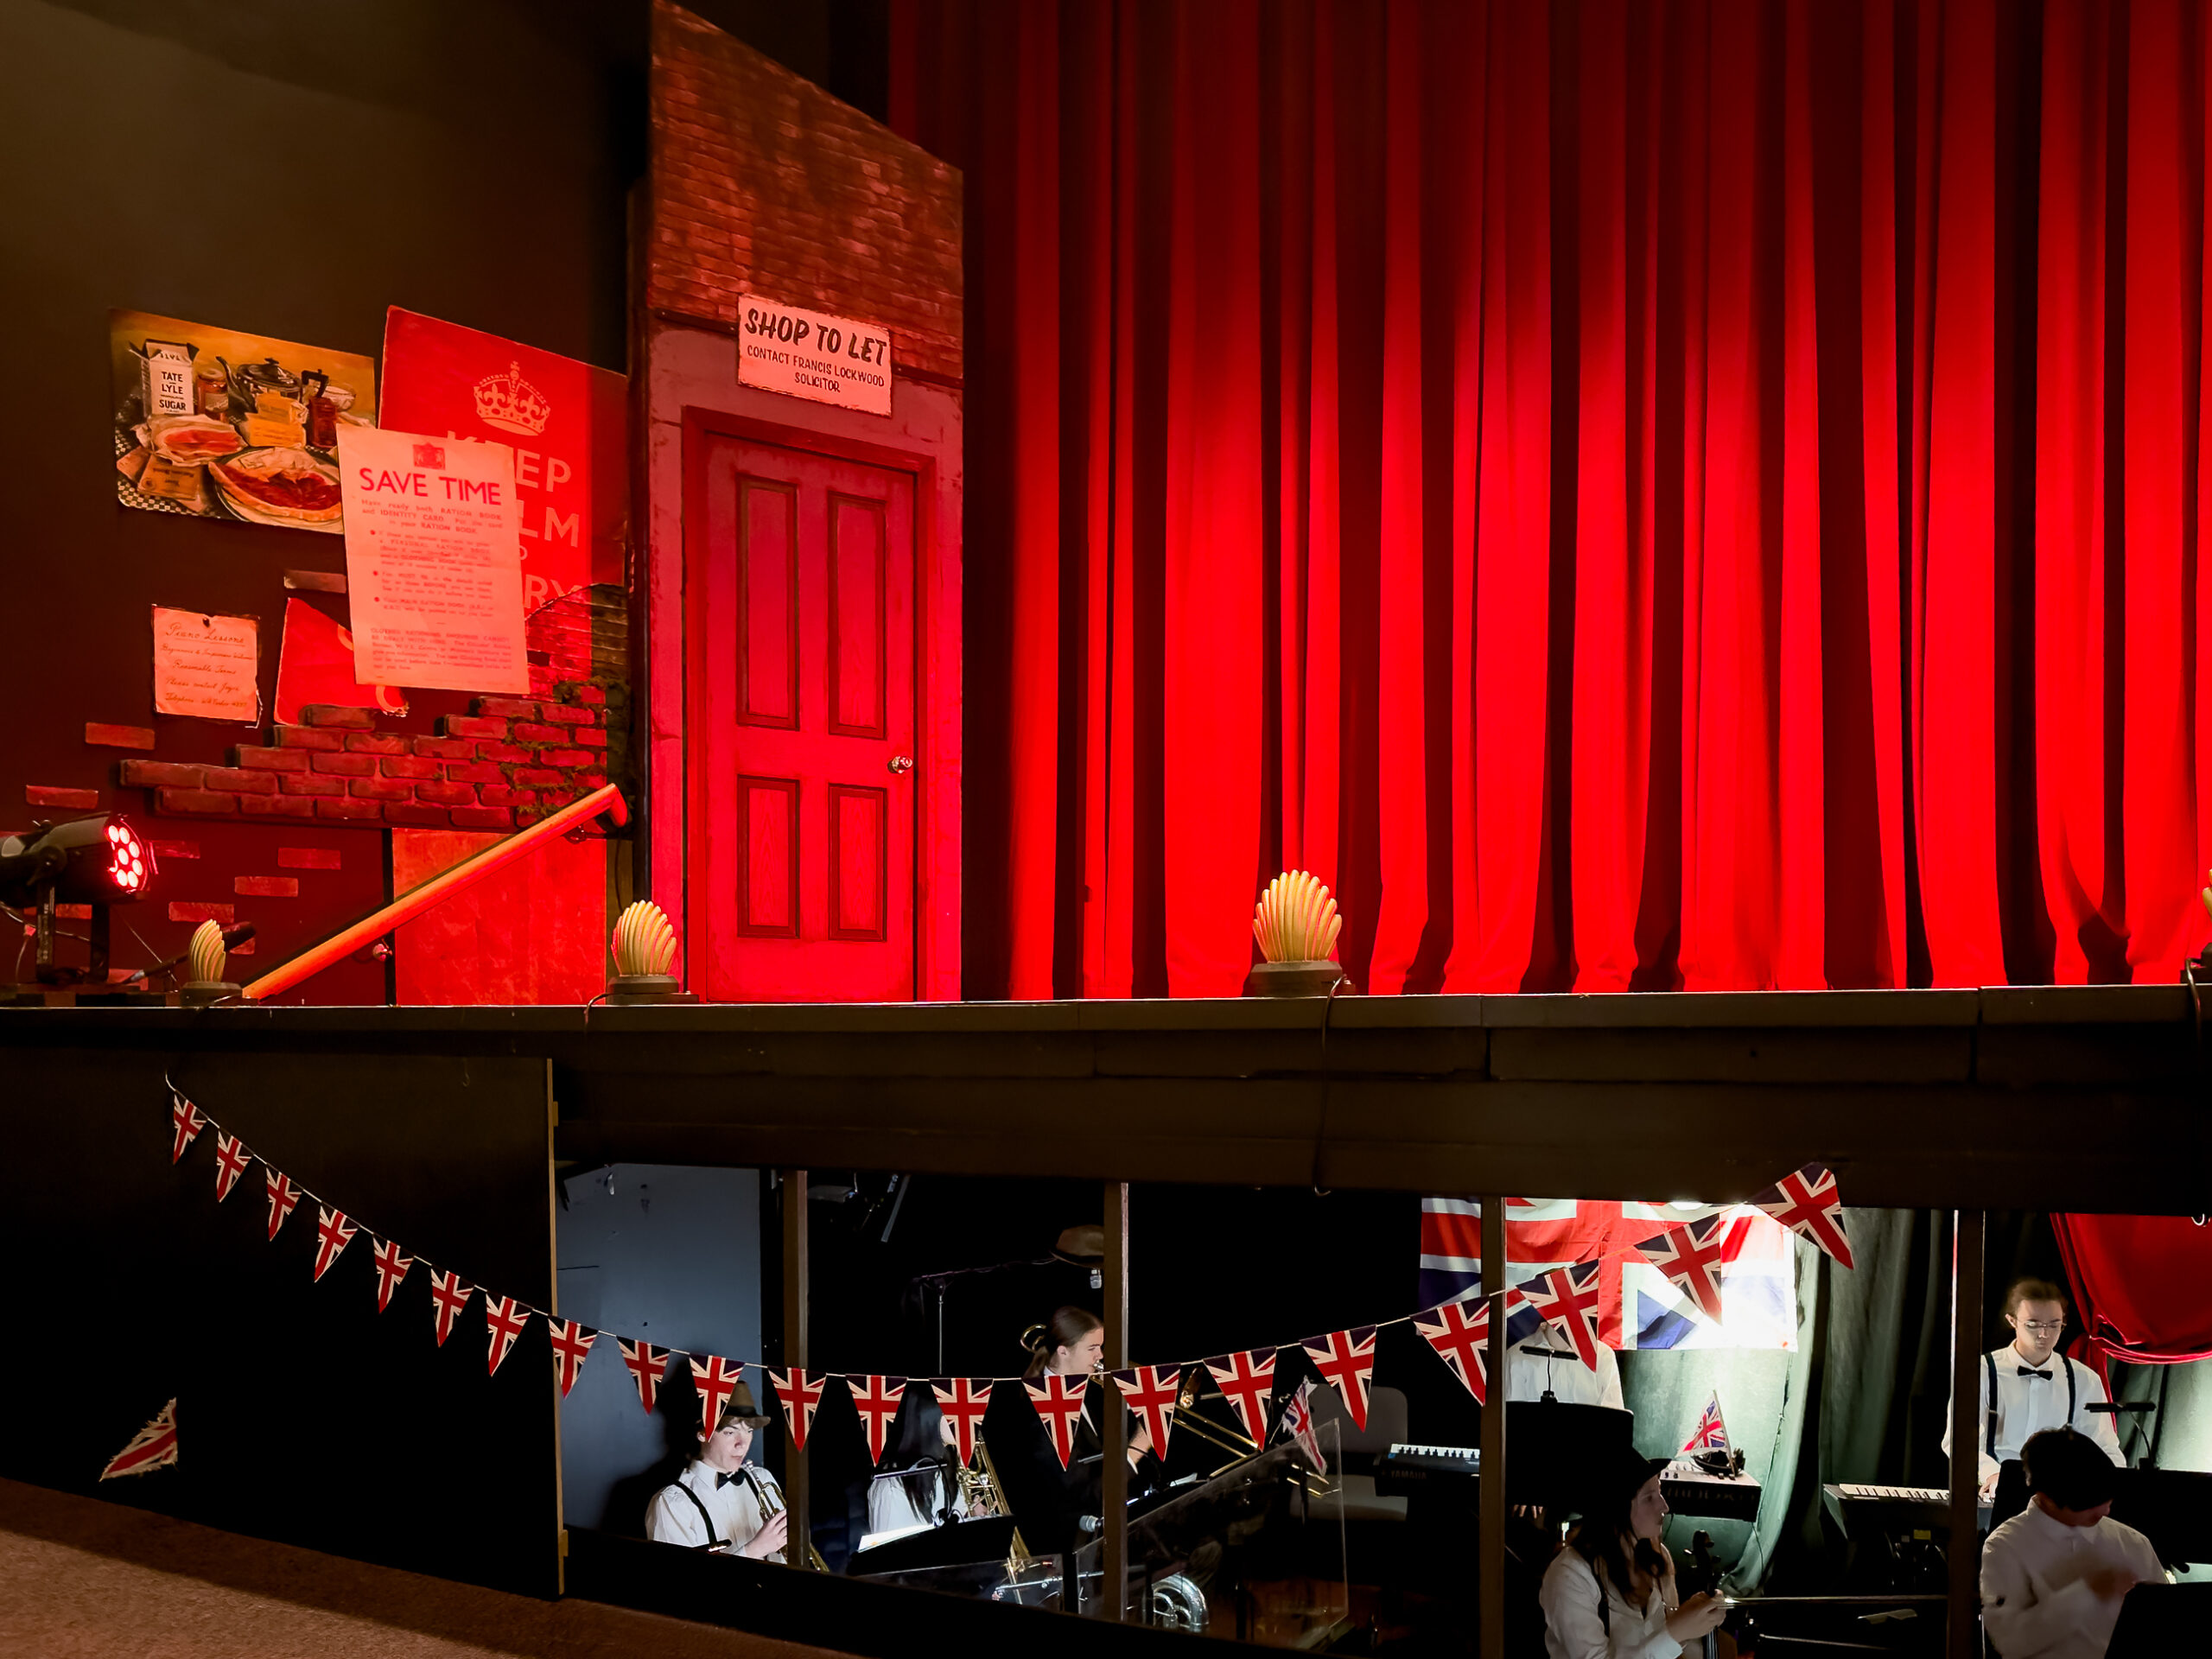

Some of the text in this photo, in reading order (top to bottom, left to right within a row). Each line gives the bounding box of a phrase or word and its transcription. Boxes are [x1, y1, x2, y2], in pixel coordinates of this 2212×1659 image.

[745, 308, 887, 366] SHOP TO LET
[161, 371, 183, 382] TATE
[747, 345, 885, 387] CONTACT FRANCIS LOCKWOOD
[162, 384, 183, 395] LYLE
[794, 372, 841, 393] SOLICITOR
[159, 399, 186, 411] SUGAR
[359, 467, 502, 505] SAVE TIME
[165, 621, 245, 644] Piano Lessons
